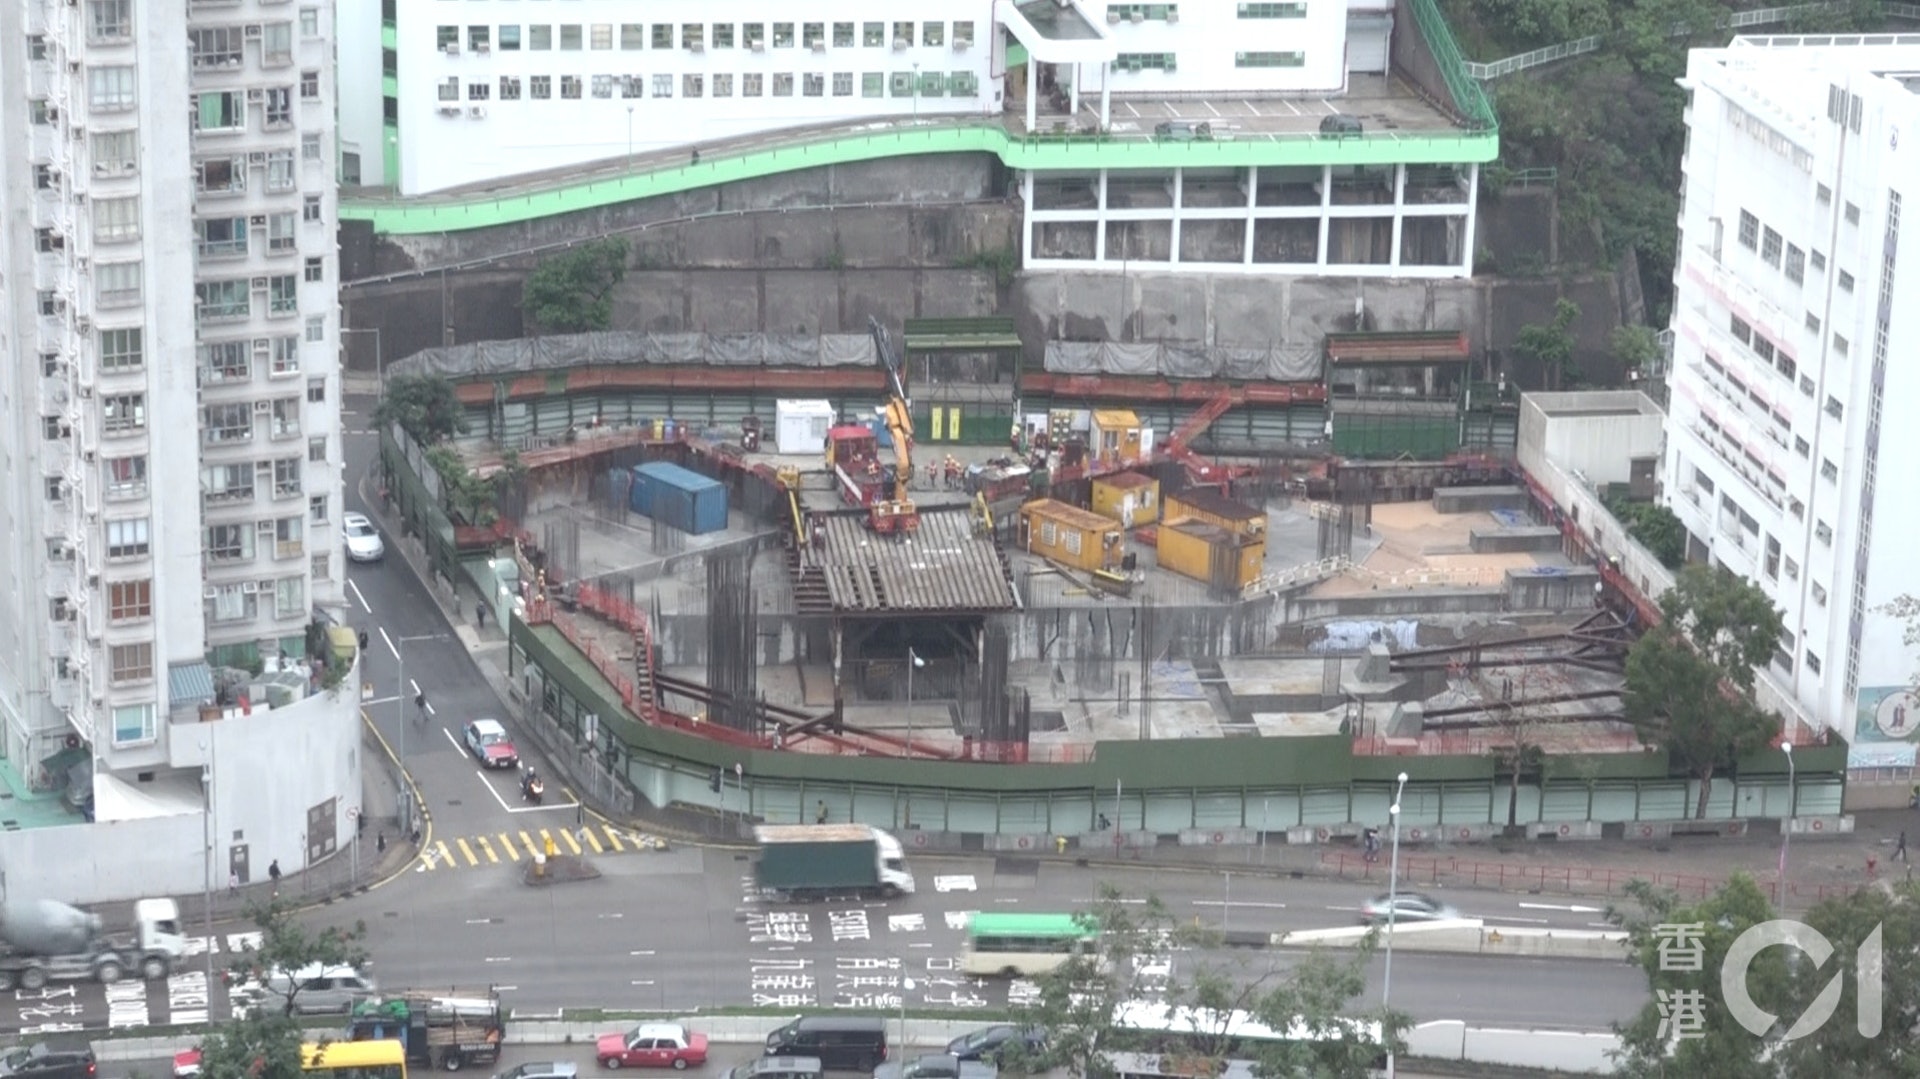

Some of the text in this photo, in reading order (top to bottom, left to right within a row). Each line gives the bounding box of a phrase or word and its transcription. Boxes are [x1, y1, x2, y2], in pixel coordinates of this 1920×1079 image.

[750, 958, 818, 1007] 九龍東
[834, 957, 902, 1008] 筲箕灣
